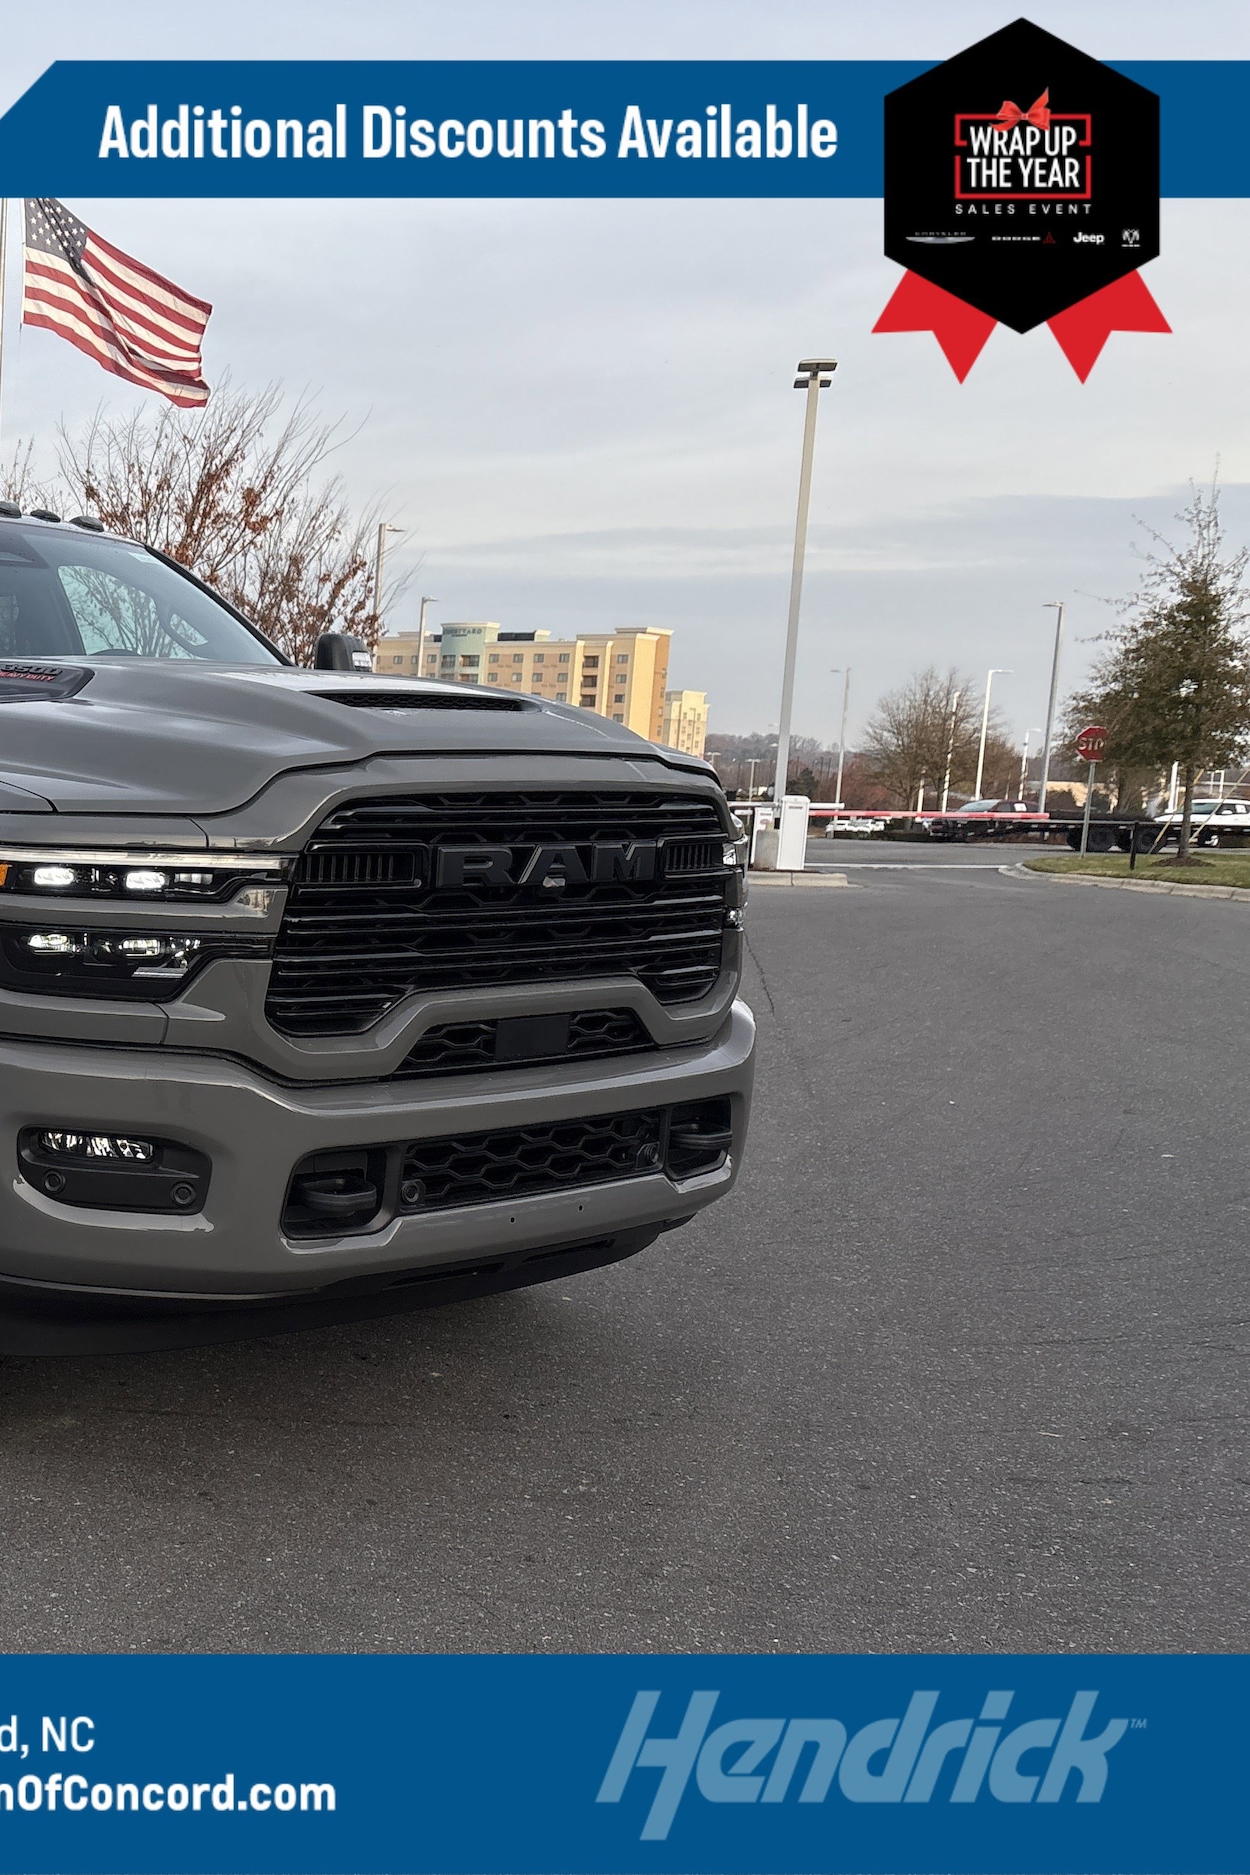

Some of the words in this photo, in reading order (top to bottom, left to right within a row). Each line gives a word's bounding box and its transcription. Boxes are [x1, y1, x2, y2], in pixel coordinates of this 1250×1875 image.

[0, 664, 63, 677] 3500
[25, 673, 56, 682] DUTY
[1078, 737, 1106, 751] STO
[436, 841, 657, 888] RAM
